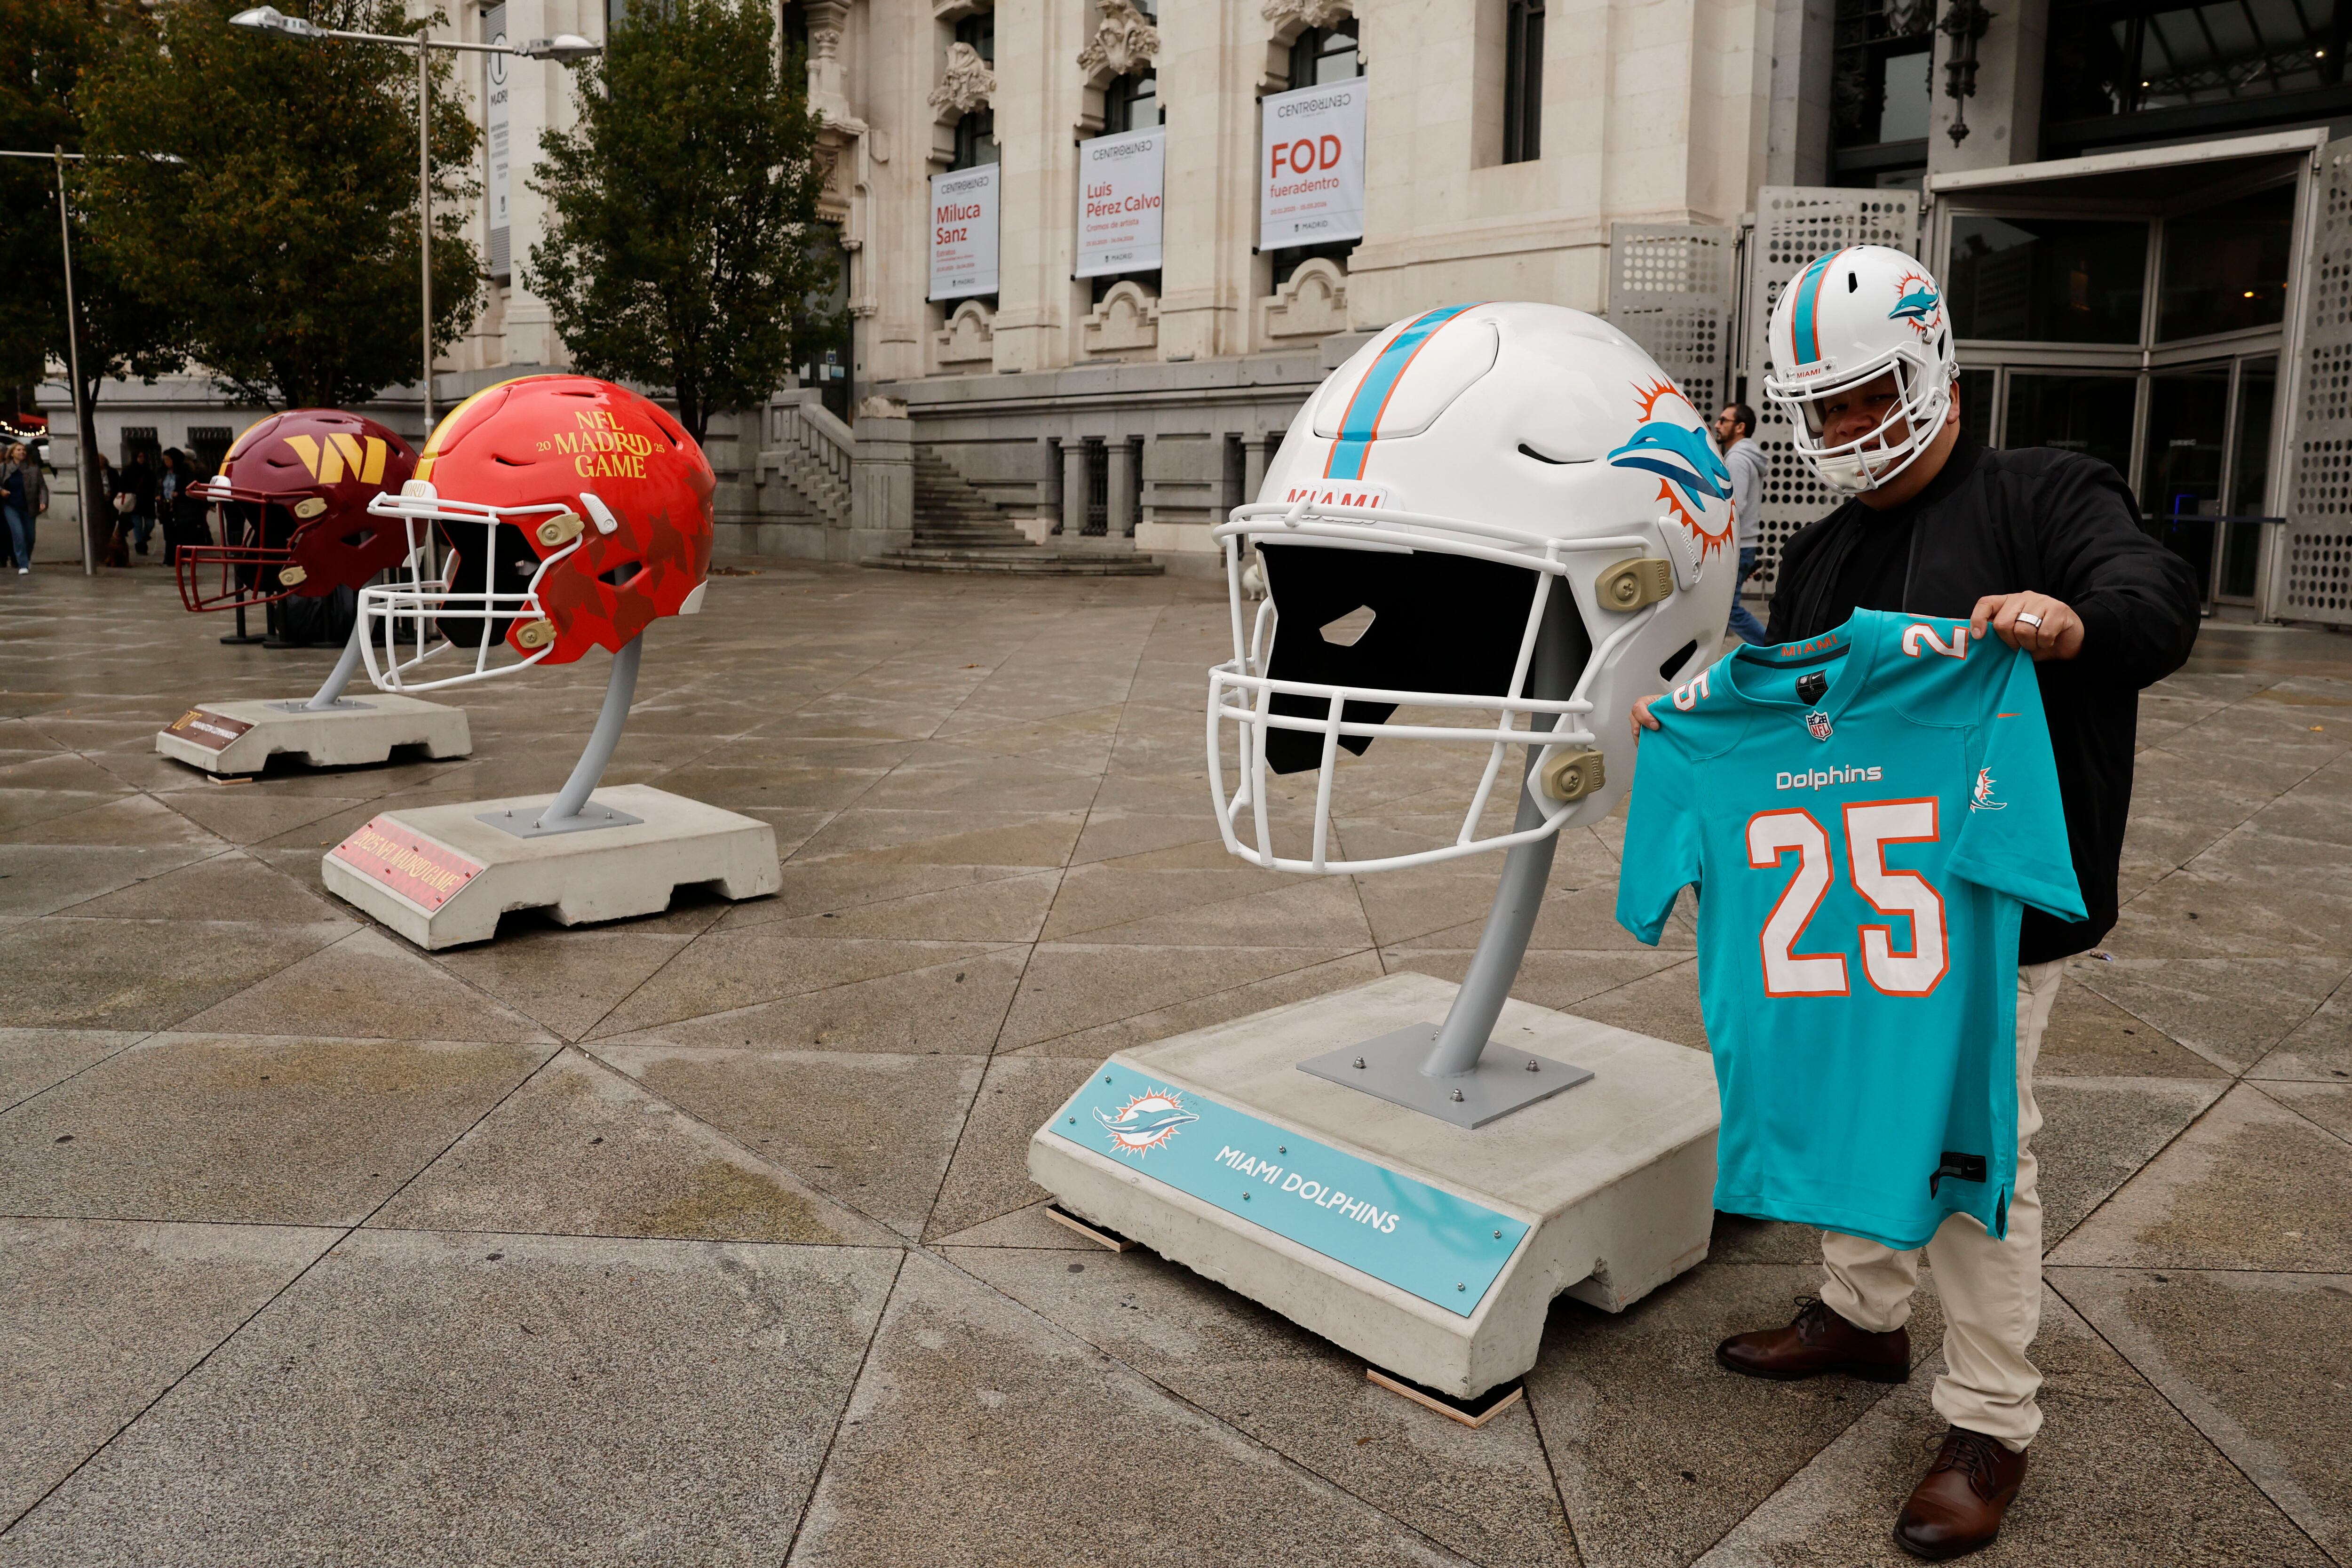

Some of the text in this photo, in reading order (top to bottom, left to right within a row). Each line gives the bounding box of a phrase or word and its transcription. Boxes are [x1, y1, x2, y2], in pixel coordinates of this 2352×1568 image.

[1272, 134, 1342, 178] FOD
[1088, 182, 1112, 199] Luis
[1270, 178, 1339, 198] fueradentro
[937, 203, 980, 224] Miluca
[1087, 194, 1160, 217] Pérez Calvo
[936, 227, 967, 245] Sanz
[1302, 220, 1328, 229] MADRID
[1797, 368, 1820, 379] MIAMI
[574, 411, 624, 430] NFL
[536, 431, 665, 456] 20 MADRID 25
[575, 454, 646, 479] GAME
[1656, 561, 1669, 598] Riddell
[1780, 634, 1838, 657] MIAMI
[1901, 622, 1969, 661] 2
[1811, 724, 1829, 737] NFL
[1591, 756, 1601, 789] Riddell
[1777, 764, 1883, 791] Dolphins
[353, 831, 460, 893] 2025 NFL MADRID GAME
[1745, 796, 1950, 998] 25
[1214, 1145, 1400, 1234] MIAMI DOLPHINS
